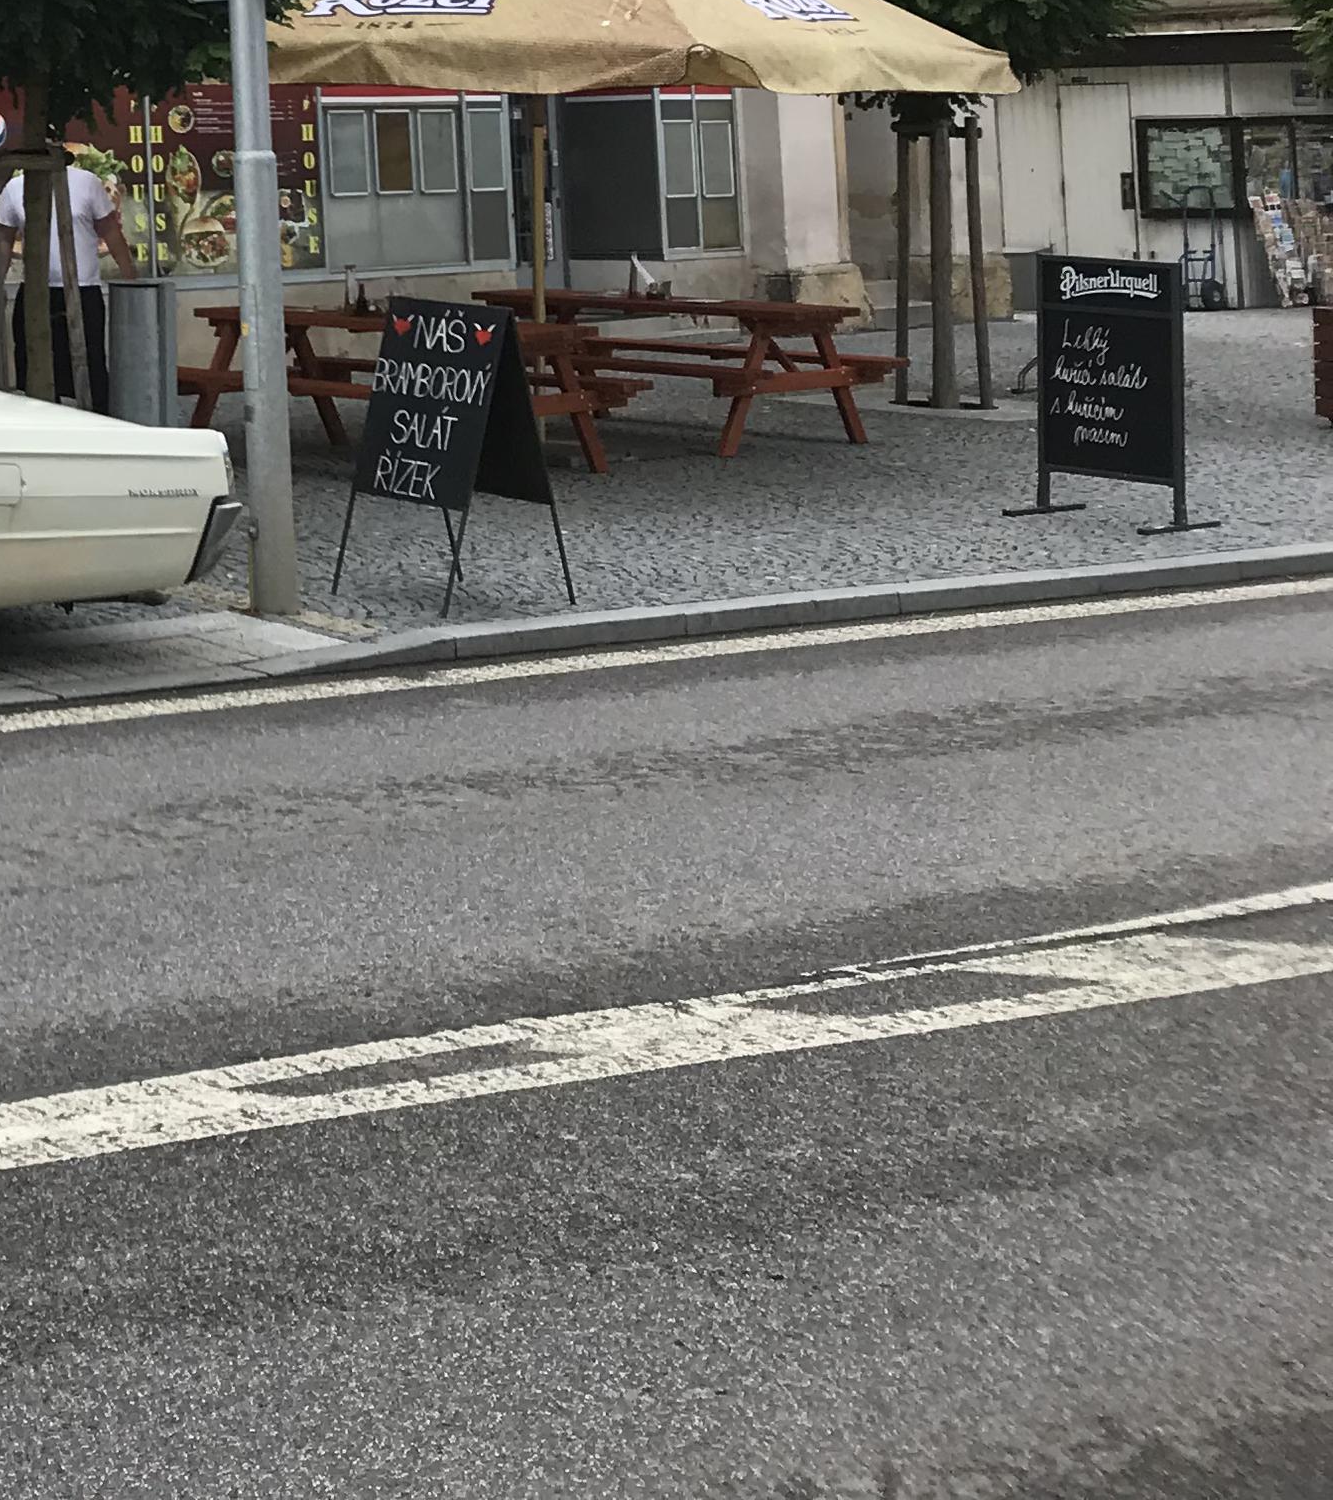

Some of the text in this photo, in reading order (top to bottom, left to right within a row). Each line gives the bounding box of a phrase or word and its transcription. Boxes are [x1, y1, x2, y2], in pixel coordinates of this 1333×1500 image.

[1060, 266, 1158, 300] Pilsner Urquell
[413, 309, 467, 353] NÁŠ
[372, 357, 492, 406] BRAMBOROVÝ
[390, 406, 459, 451] SALÁT
[373, 449, 441, 501] ŘÍZEK
